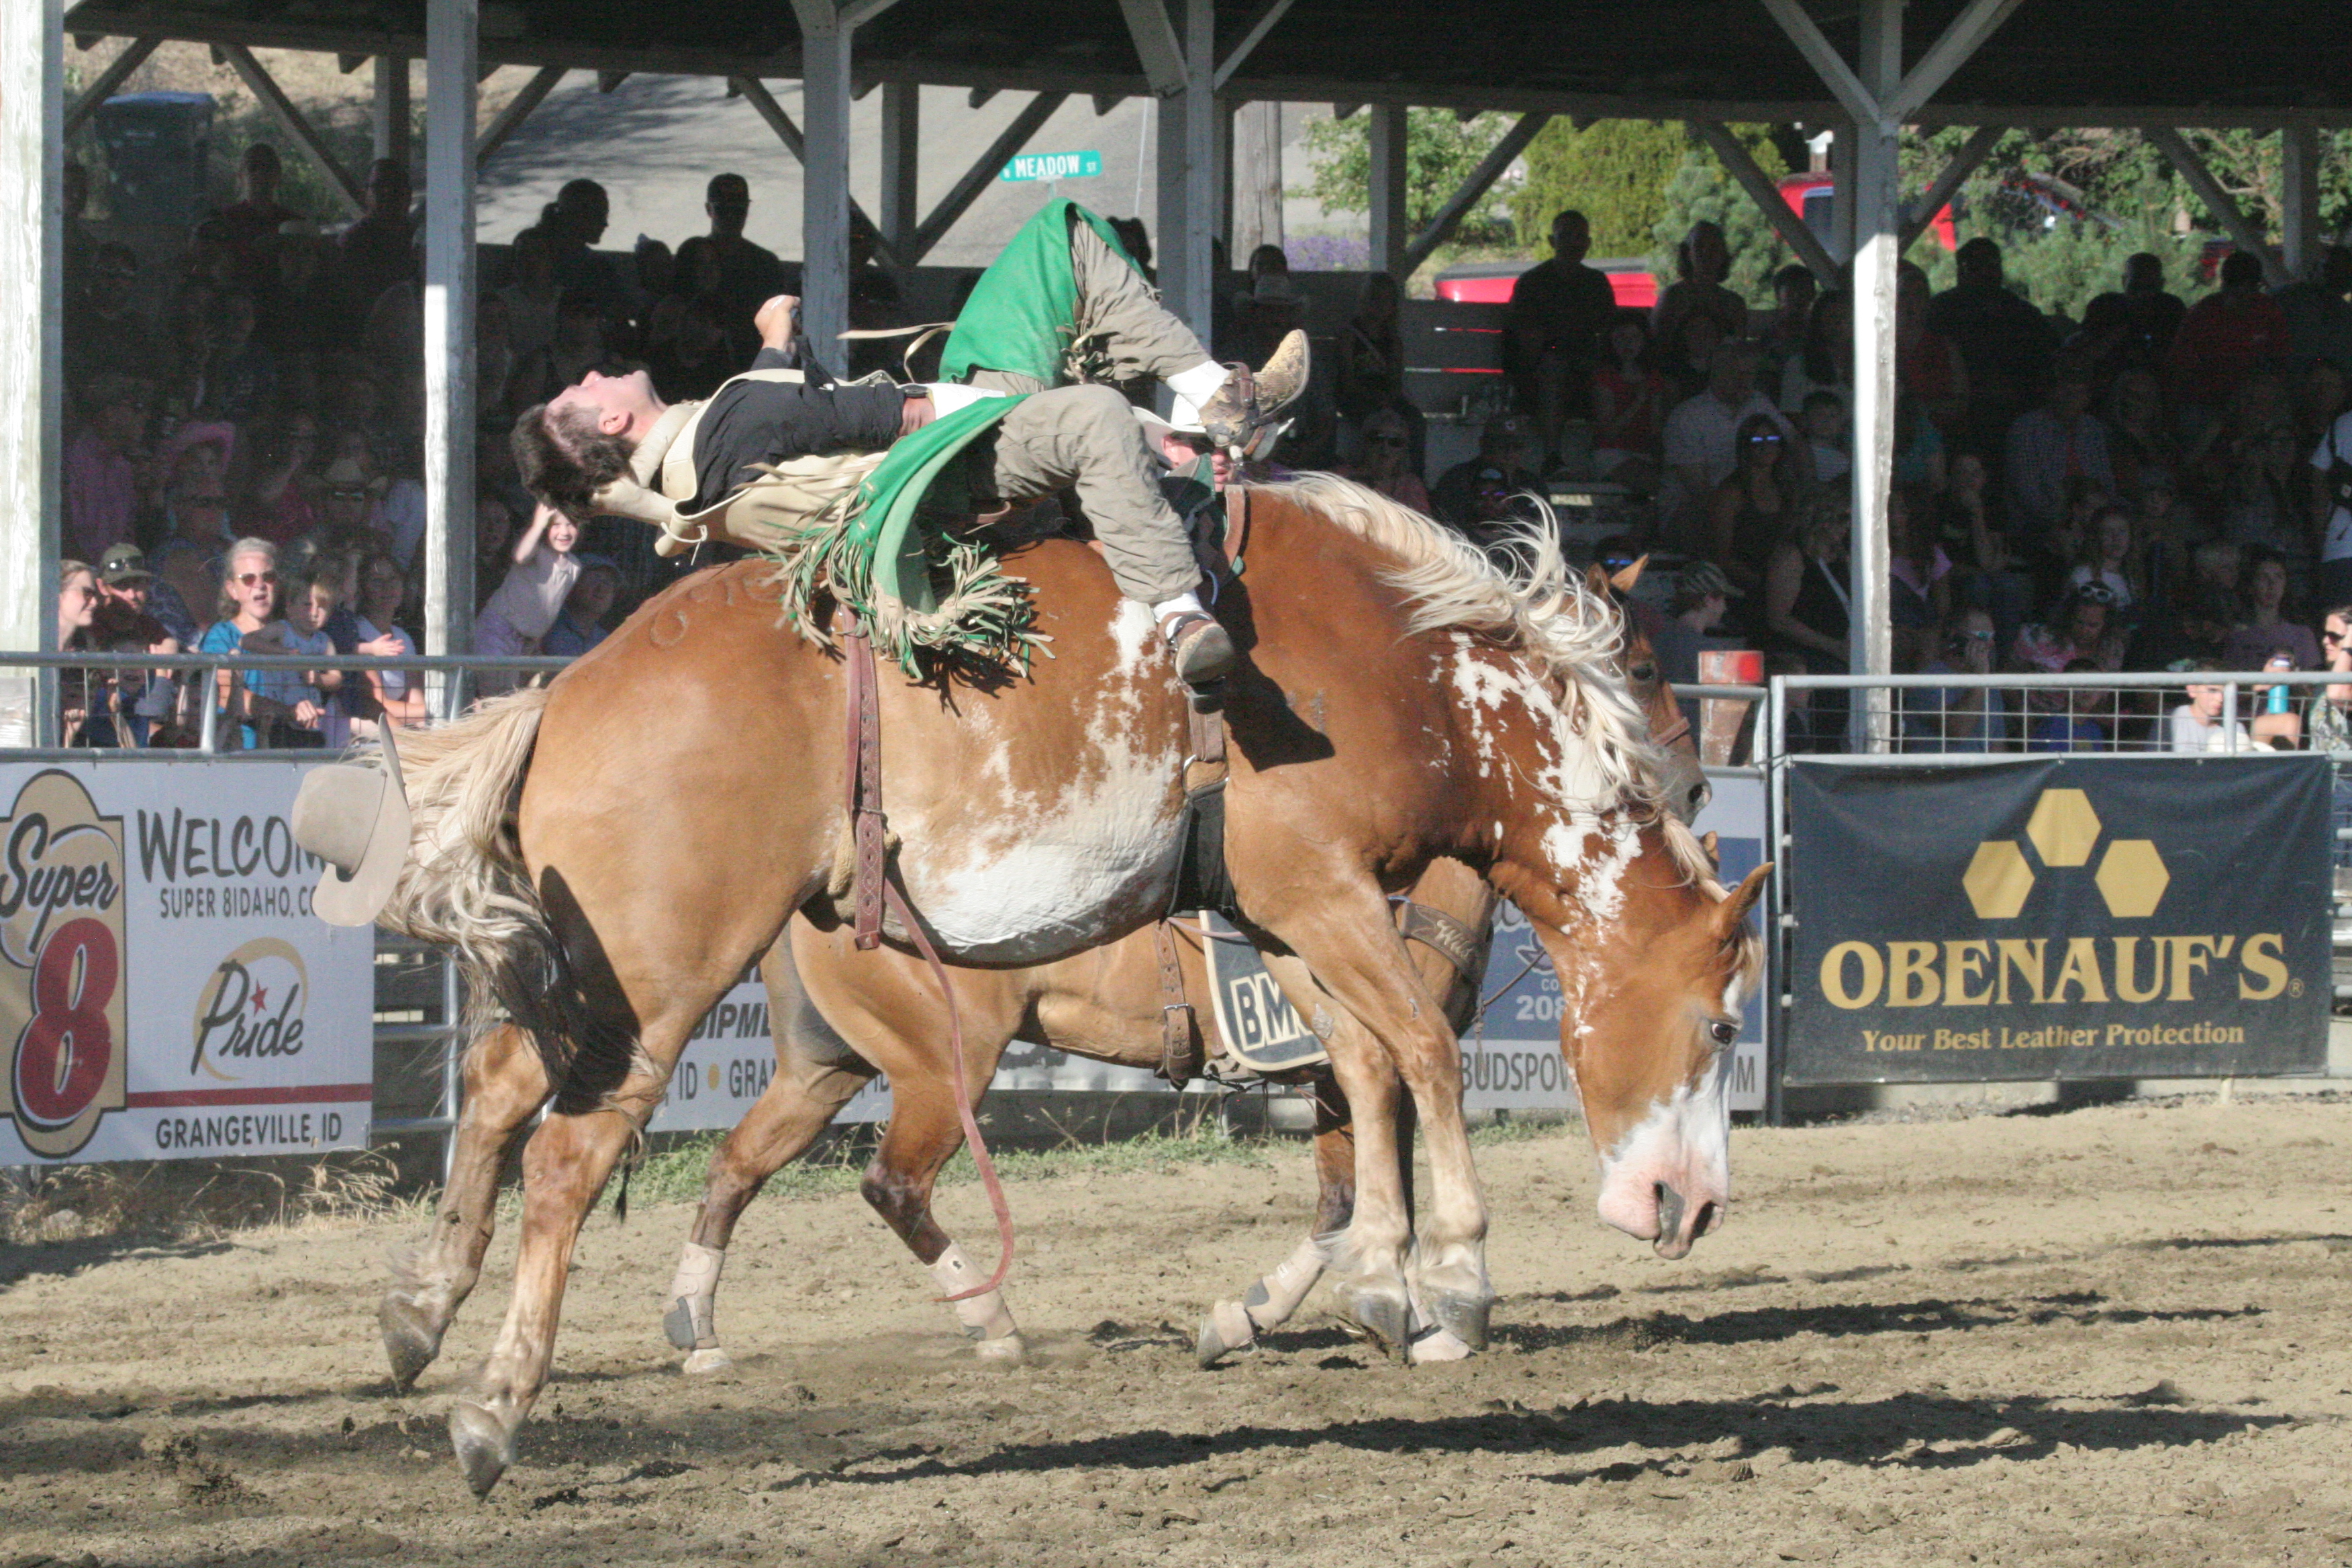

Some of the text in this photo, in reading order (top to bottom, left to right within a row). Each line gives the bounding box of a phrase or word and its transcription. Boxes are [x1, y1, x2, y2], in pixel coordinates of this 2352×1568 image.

[1014, 154, 1080, 178] MEADOW
[0, 813, 119, 954] Super
[160, 887, 215, 918] SUPER
[12, 917, 119, 1128] 8
[191, 959, 303, 1075] Pride
[1230, 971, 1314, 1052] BM
[1862, 1020, 2245, 1052] Your Best Leather Protection
[322, 1112, 342, 1142] ID
